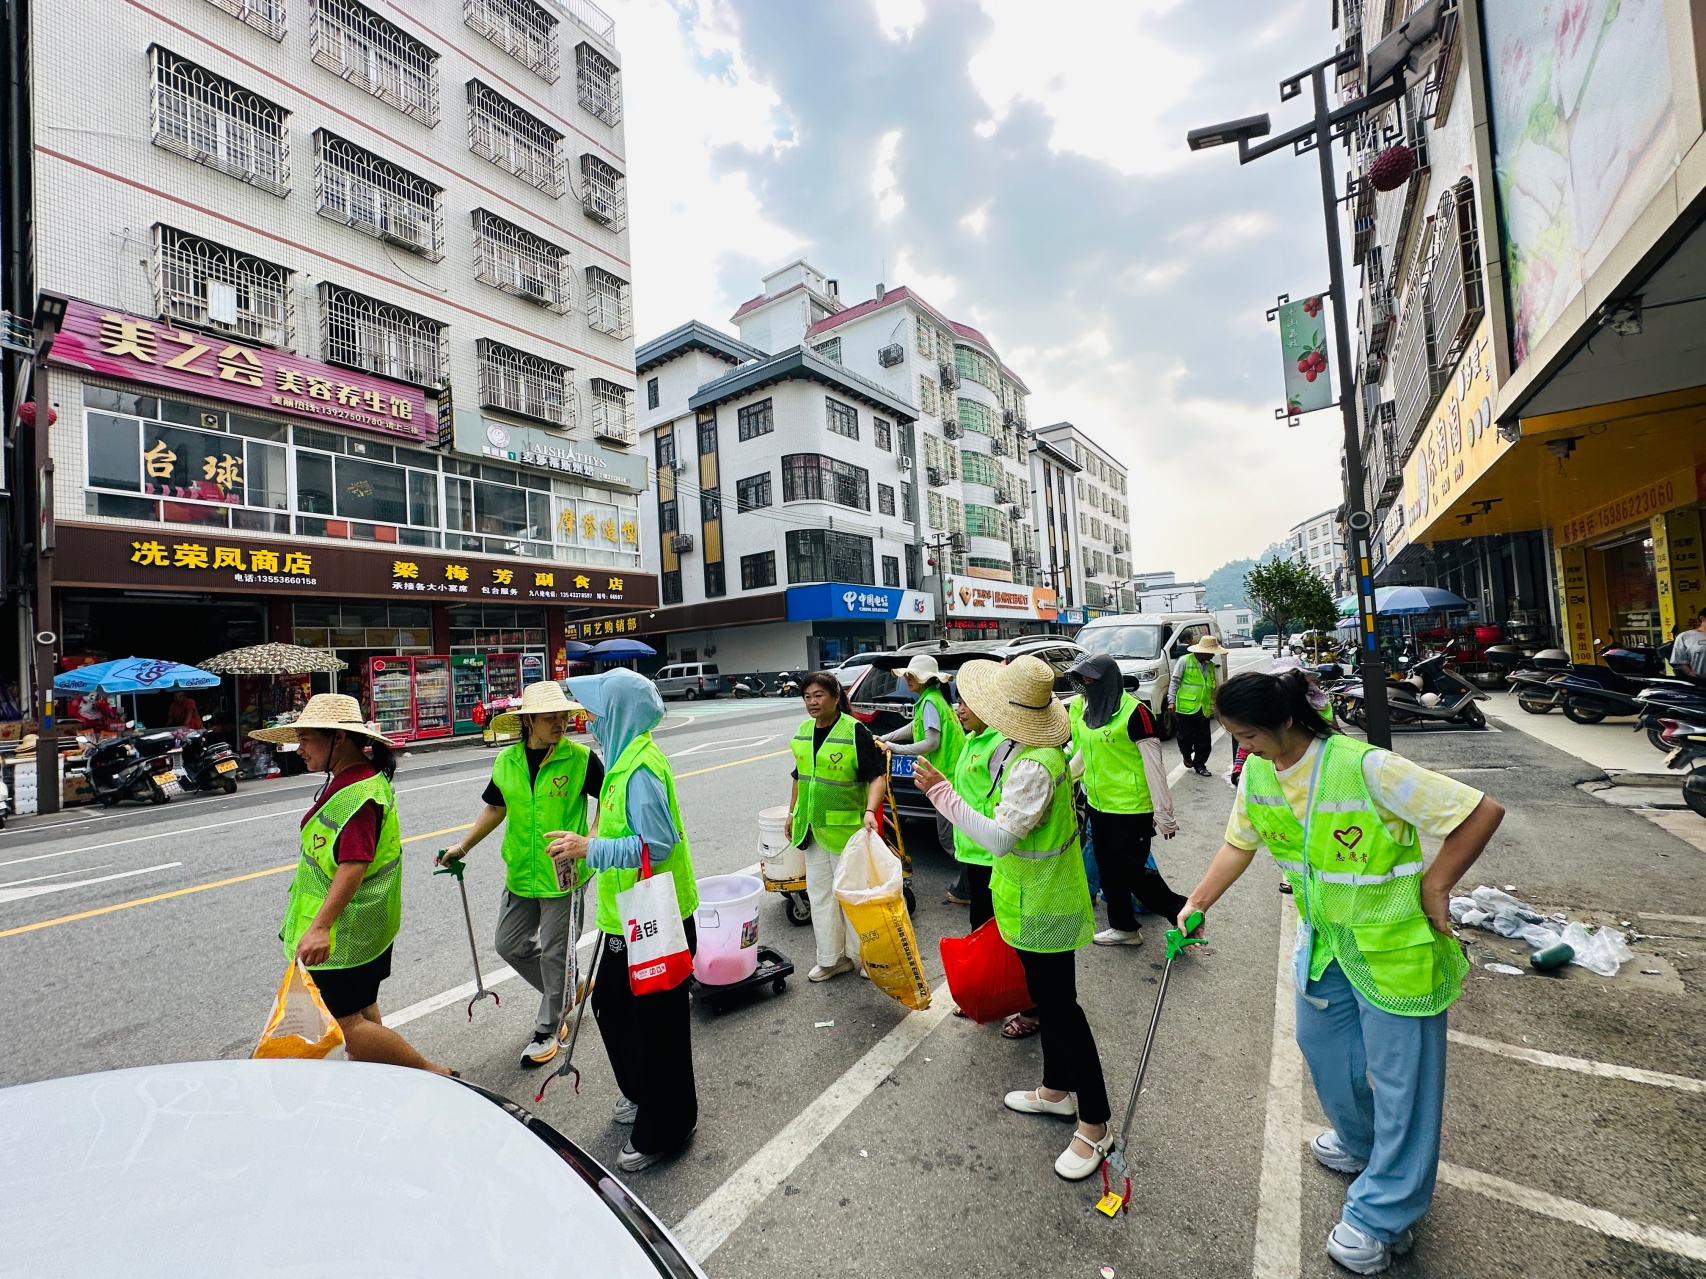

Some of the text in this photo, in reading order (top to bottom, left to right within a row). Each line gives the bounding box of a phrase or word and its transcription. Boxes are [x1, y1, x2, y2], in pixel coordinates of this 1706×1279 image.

[99, 313, 264, 388] 美之会
[276, 366, 413, 421] 美容养生馆
[144, 439, 244, 490] 台球
[557, 508, 638, 545] 摩登造型
[130, 540, 312, 575] 冼荣凤商店
[391, 581, 469, 593] 承接各大小宴席
[392, 560, 624, 591] 梁梅芳副食店
[858, 592, 889, 607] 中国电信
[913, 598, 925, 614] 5G
[583, 617, 637, 636] 阿艺购销部
[1335, 851, 1368, 863] 志愿者
